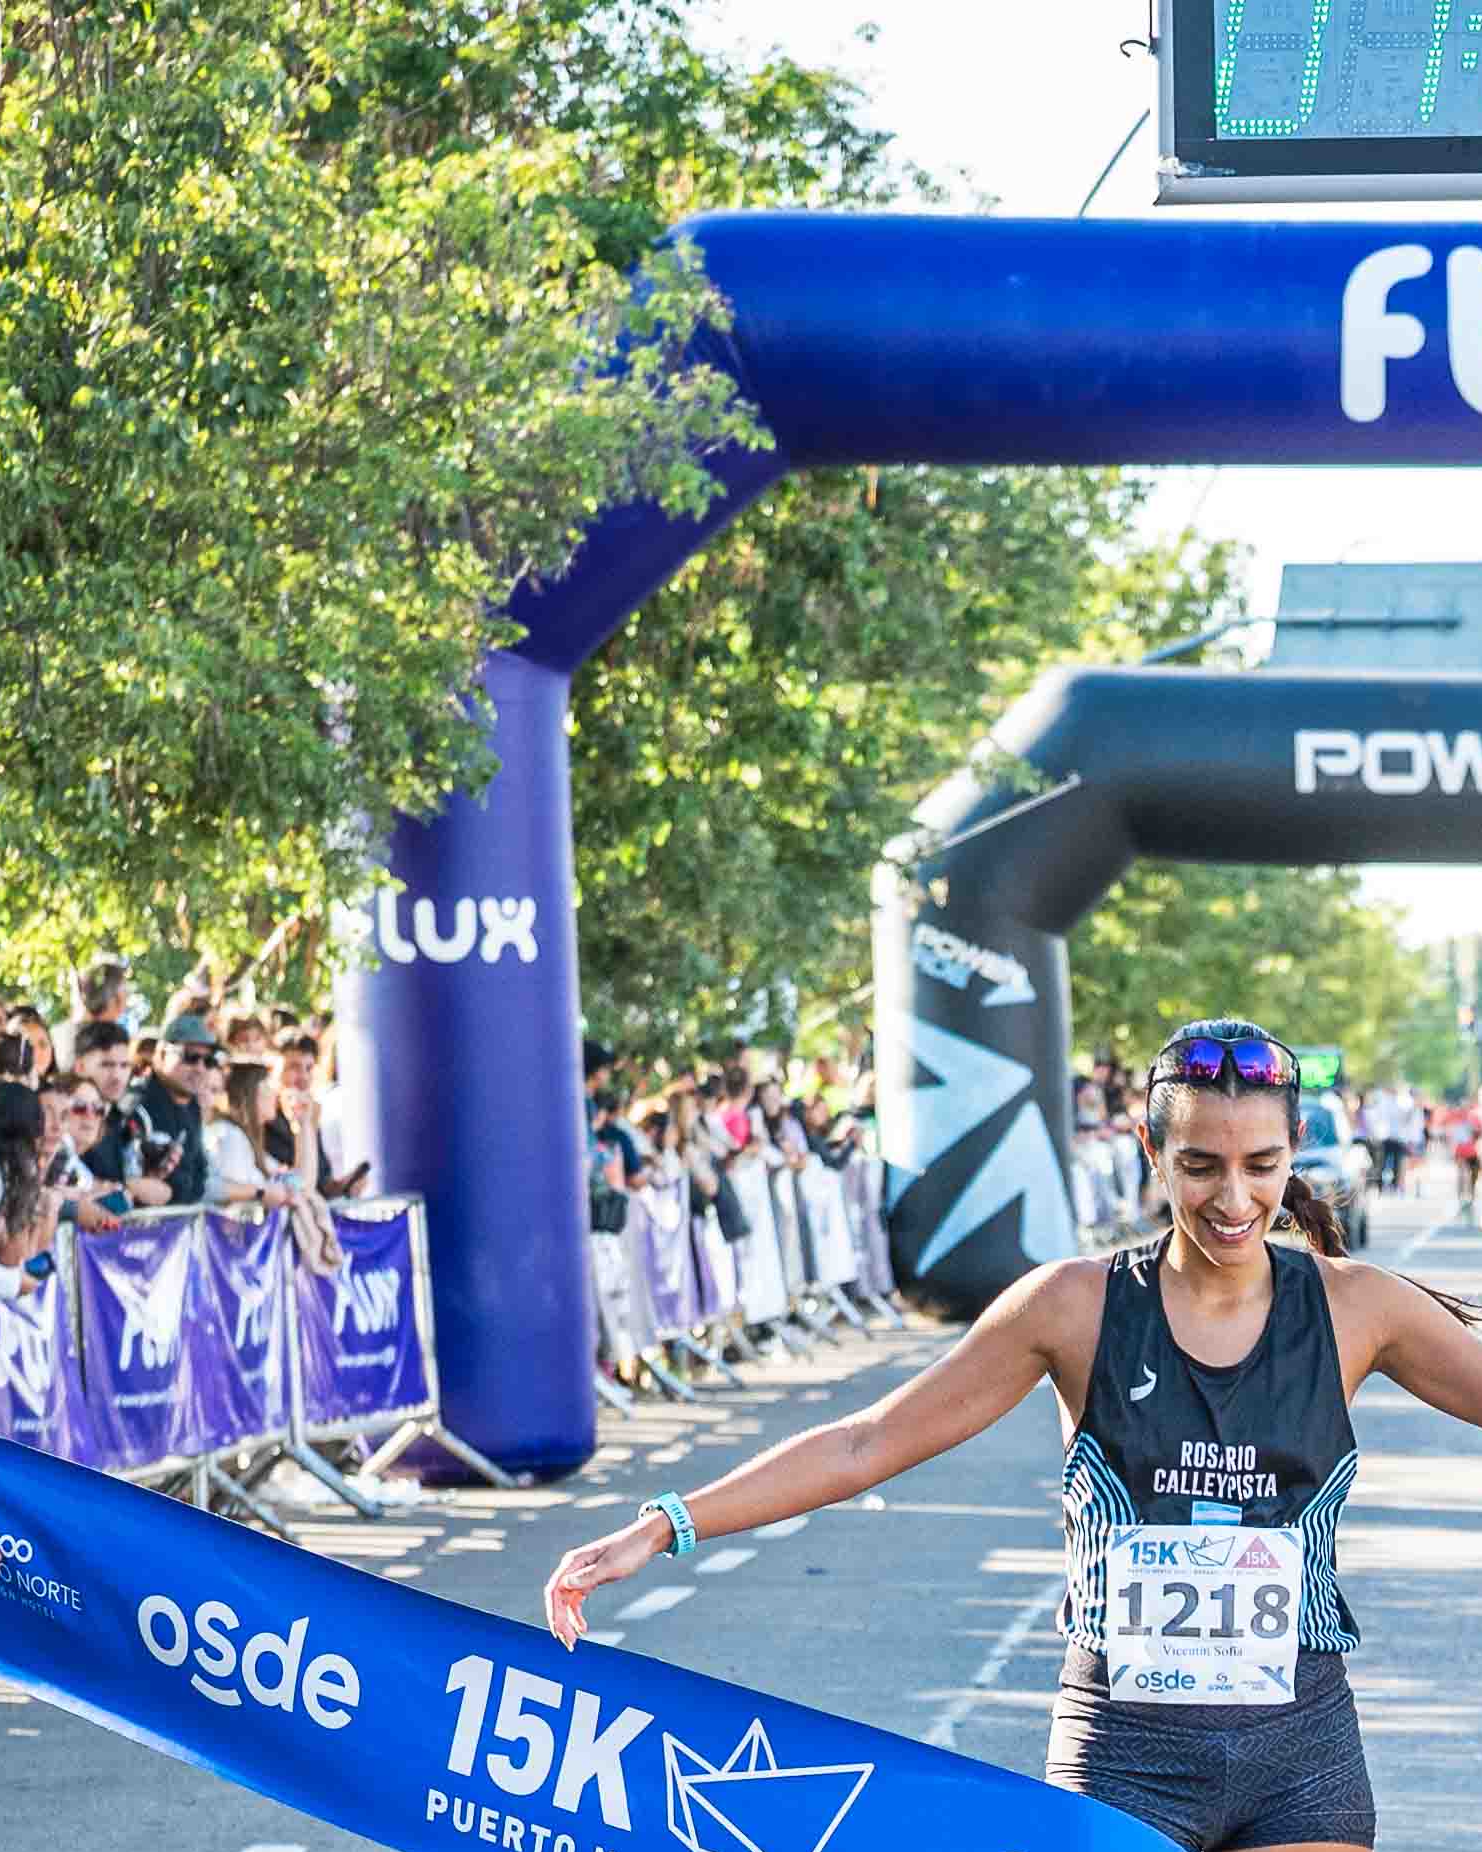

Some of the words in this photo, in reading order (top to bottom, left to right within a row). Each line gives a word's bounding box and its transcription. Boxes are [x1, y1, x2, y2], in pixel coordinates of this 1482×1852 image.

[376, 886, 539, 964] lux
[1129, 1541, 1179, 1566] 15K
[1245, 1551, 1271, 1566] 15K
[17, 1569, 83, 1611] NORTE
[1118, 1582, 1291, 1640] 1218
[136, 1594, 361, 1730] osde
[1135, 1669, 1197, 1693] osde
[445, 1654, 654, 1833] 15K
